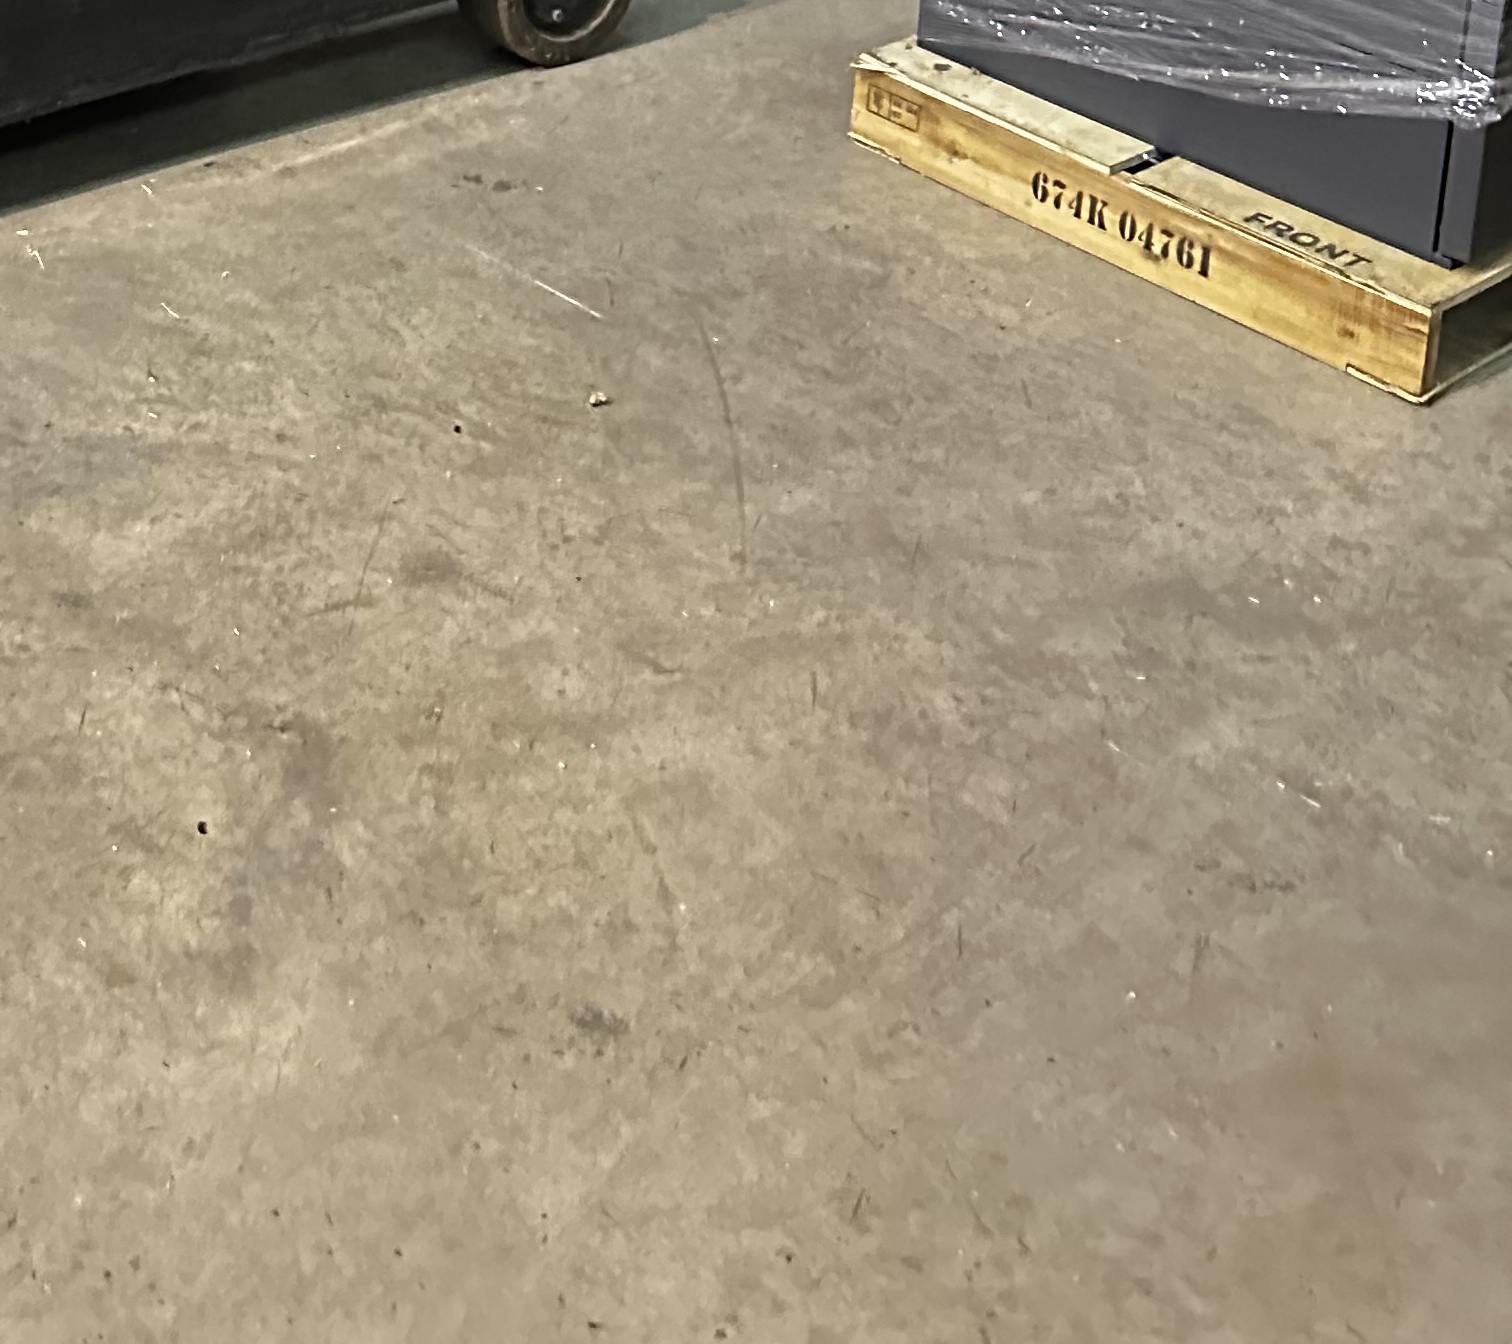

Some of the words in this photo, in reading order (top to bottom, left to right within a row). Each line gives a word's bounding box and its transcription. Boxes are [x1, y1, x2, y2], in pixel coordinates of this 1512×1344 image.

[1031, 171, 1110, 231] 674K
[1118, 210, 1212, 279] 04761
[1242, 211, 1374, 267] FRONT
